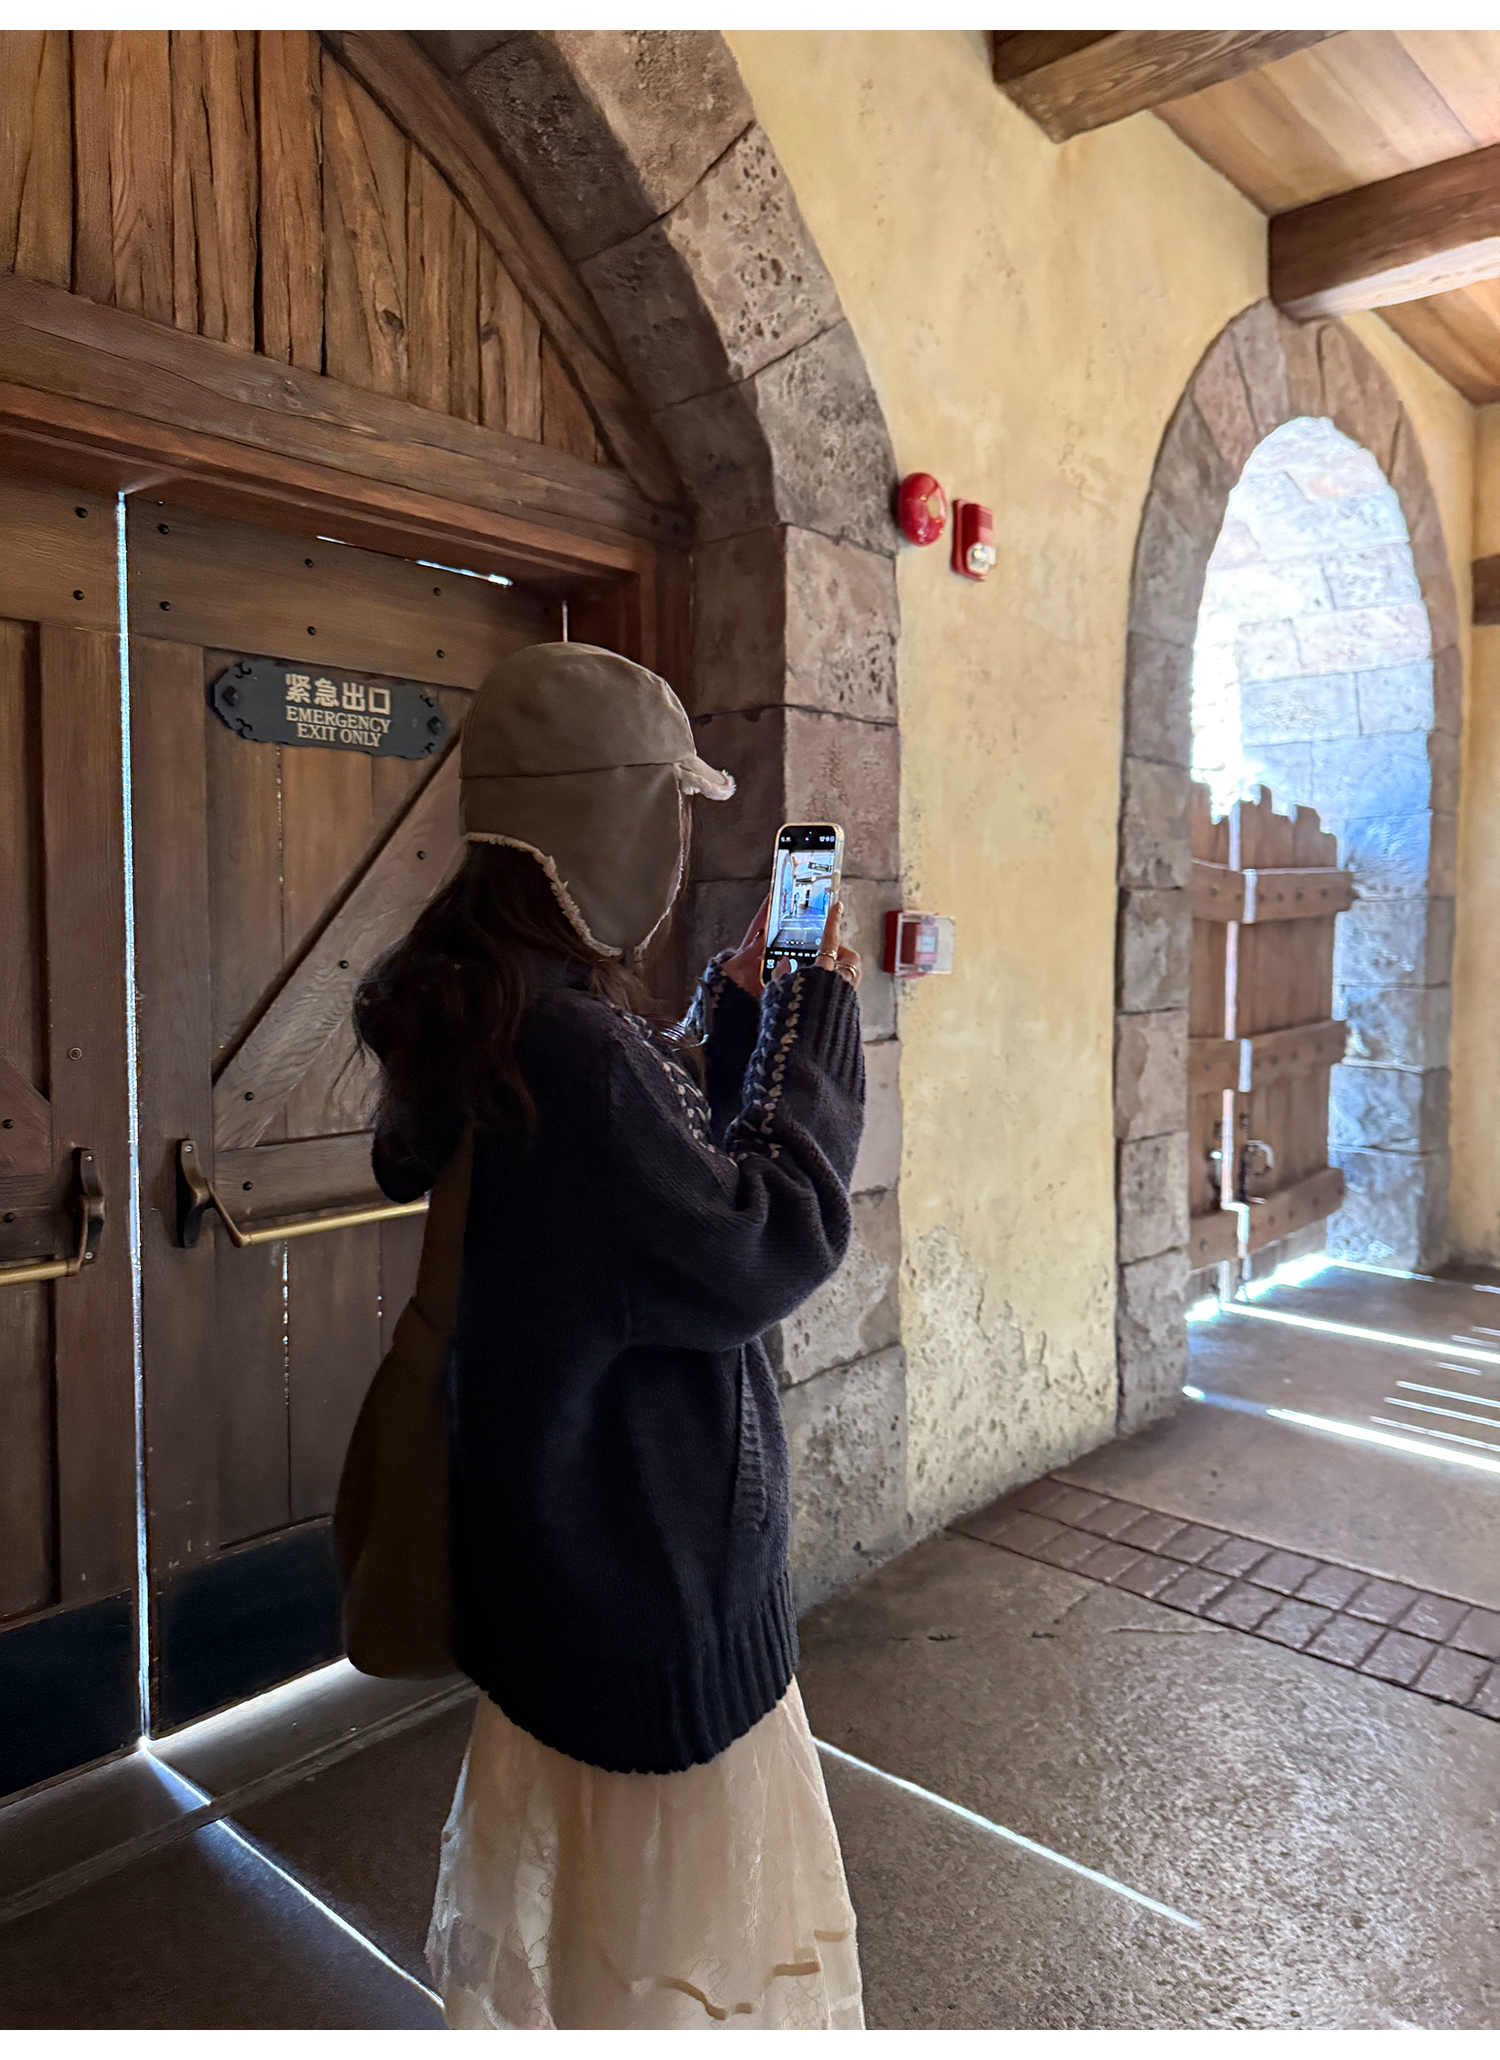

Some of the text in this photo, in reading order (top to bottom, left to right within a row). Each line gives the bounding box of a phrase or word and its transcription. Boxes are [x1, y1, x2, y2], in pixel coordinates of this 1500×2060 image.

[285, 673, 391, 715] 紧急出口
[285, 705, 391, 733] EMERGENCY
[297, 723, 382, 747] EXIT ONLY
